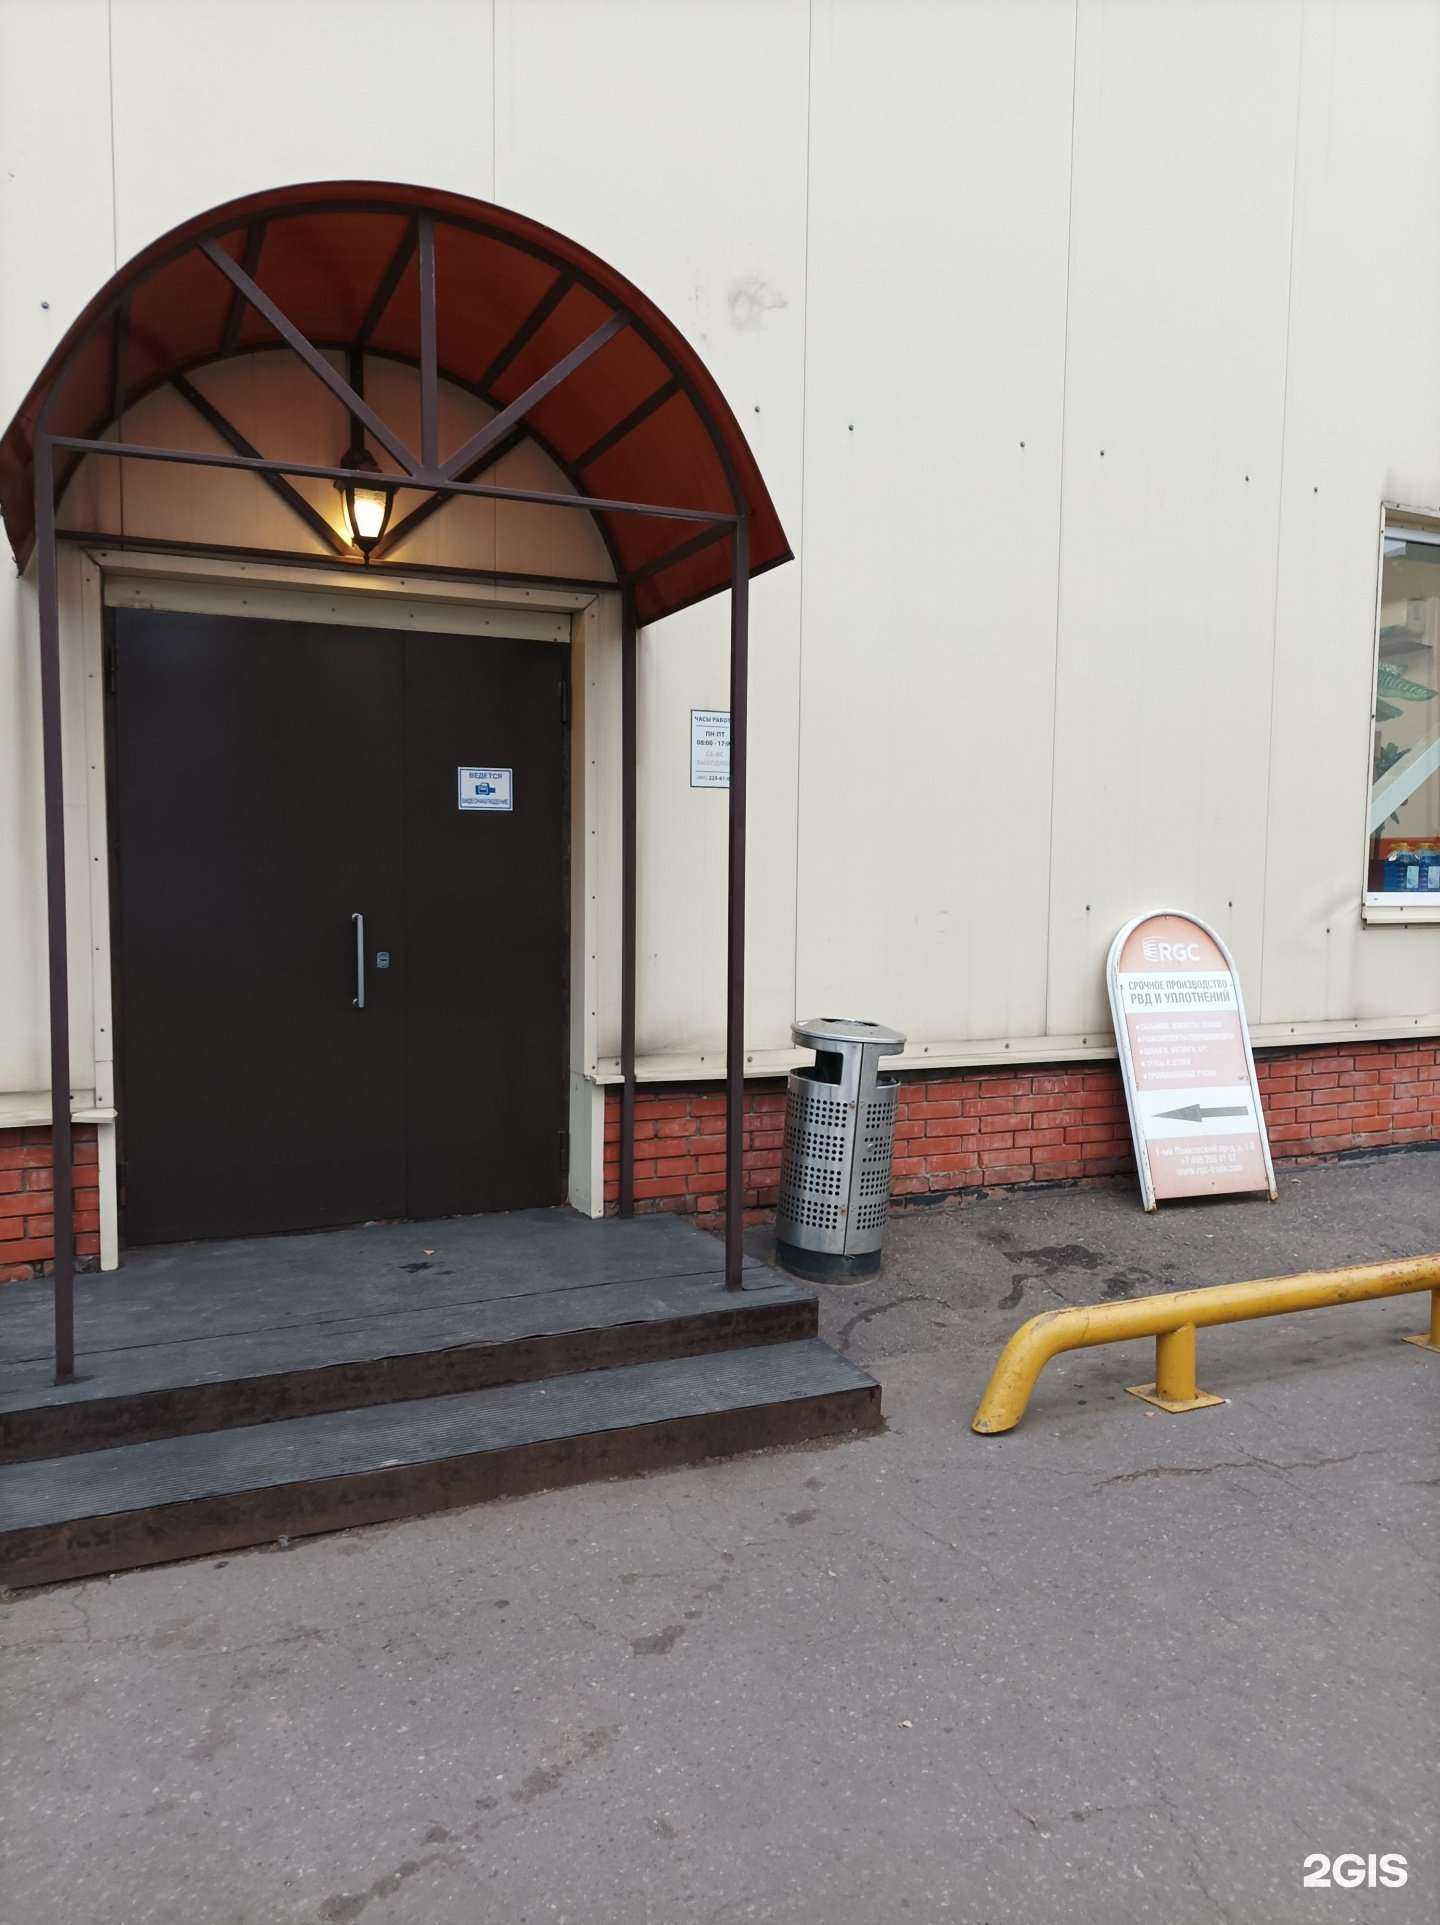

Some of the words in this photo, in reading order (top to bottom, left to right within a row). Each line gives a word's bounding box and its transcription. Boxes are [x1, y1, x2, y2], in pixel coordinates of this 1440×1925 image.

[1158, 943, 1201, 961] RGC
[1128, 981, 1165, 990] СРОЧНОЕ
[1166, 980, 1228, 990] ПРОИЗВОДСТВО
[1131, 993, 1153, 1006] РВД
[1155, 993, 1163, 1004] И
